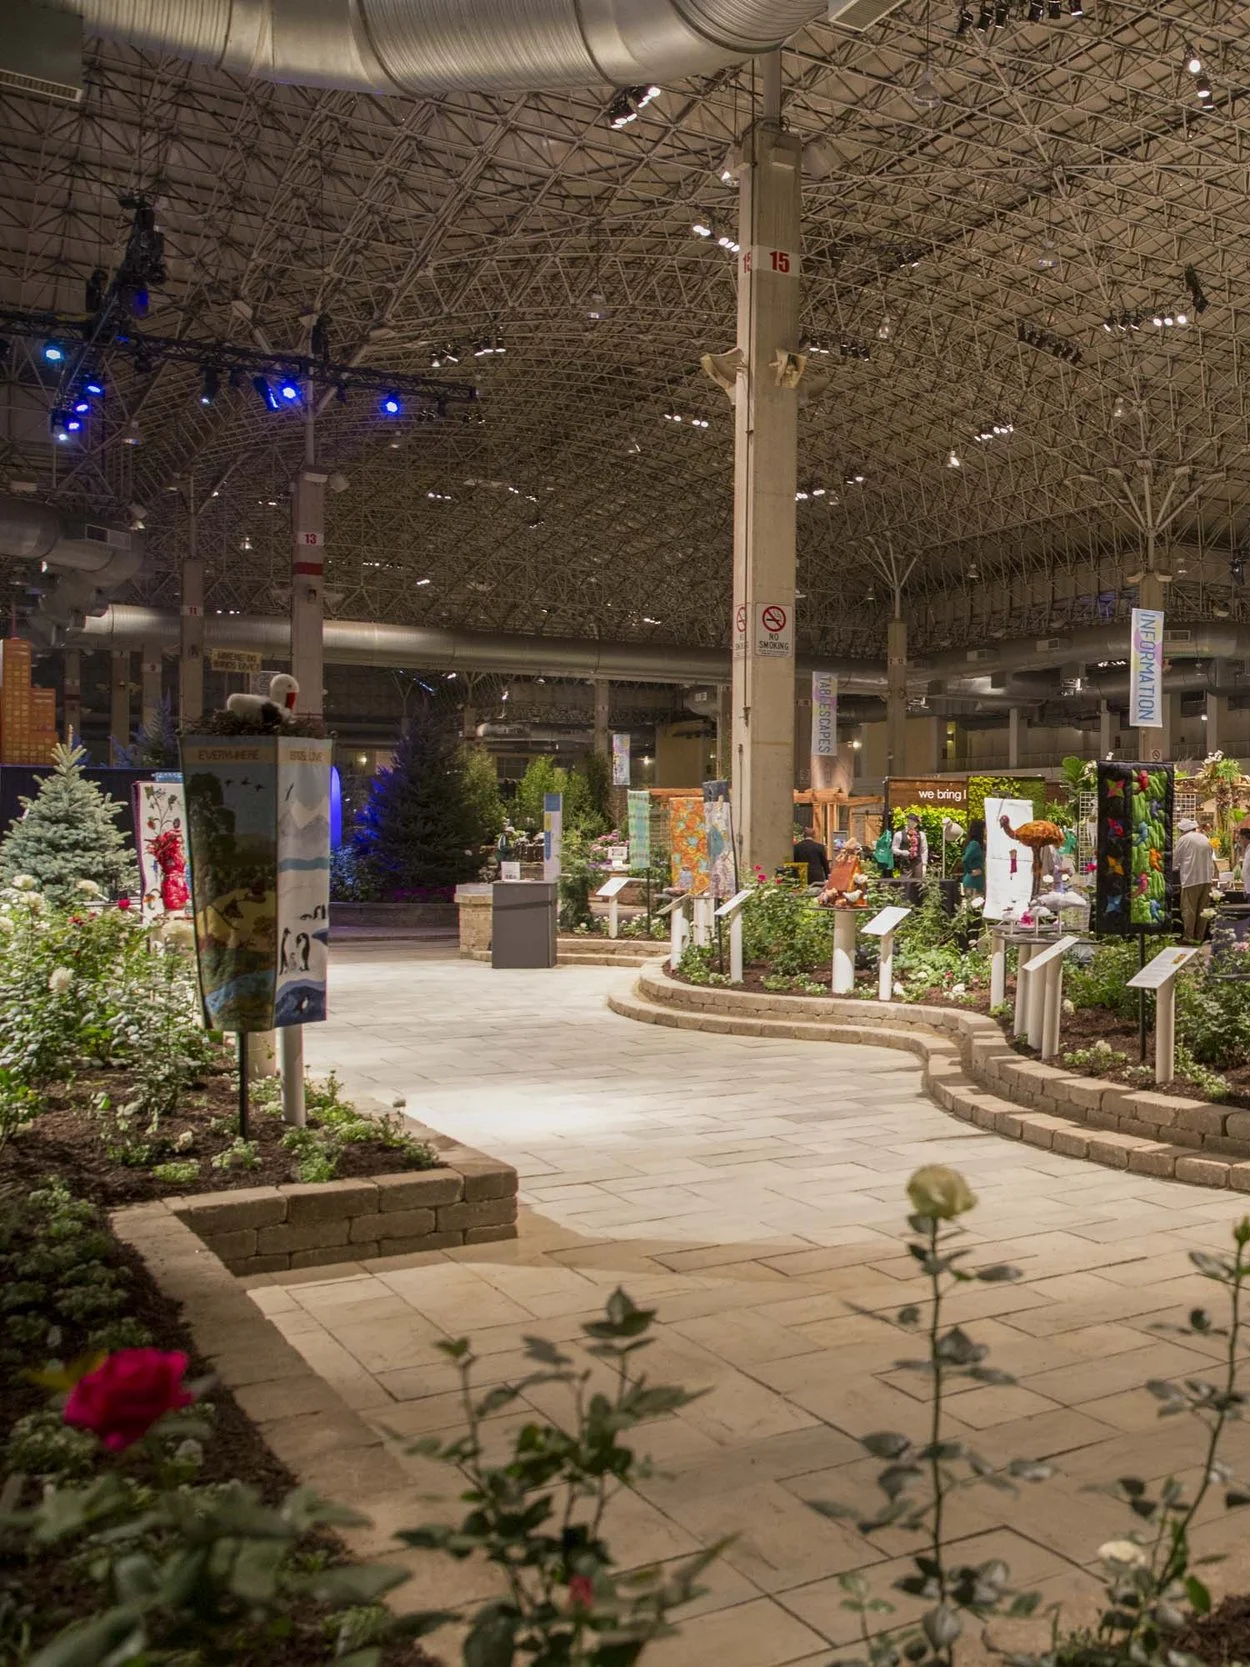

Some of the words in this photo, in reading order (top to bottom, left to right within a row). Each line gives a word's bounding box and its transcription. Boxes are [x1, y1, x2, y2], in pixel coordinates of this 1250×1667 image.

[769, 251, 790, 273] 15
[304, 533, 317, 544] 13
[768, 632, 780, 641] NO
[759, 640, 790, 650] SMOKING
[1138, 613, 1156, 721] INFORMATION
[818, 676, 832, 753] TABLESCAPES
[199, 749, 260, 760] EVERYWHERE
[918, 790, 935, 799] we
[937, 789, 962, 802] bring
